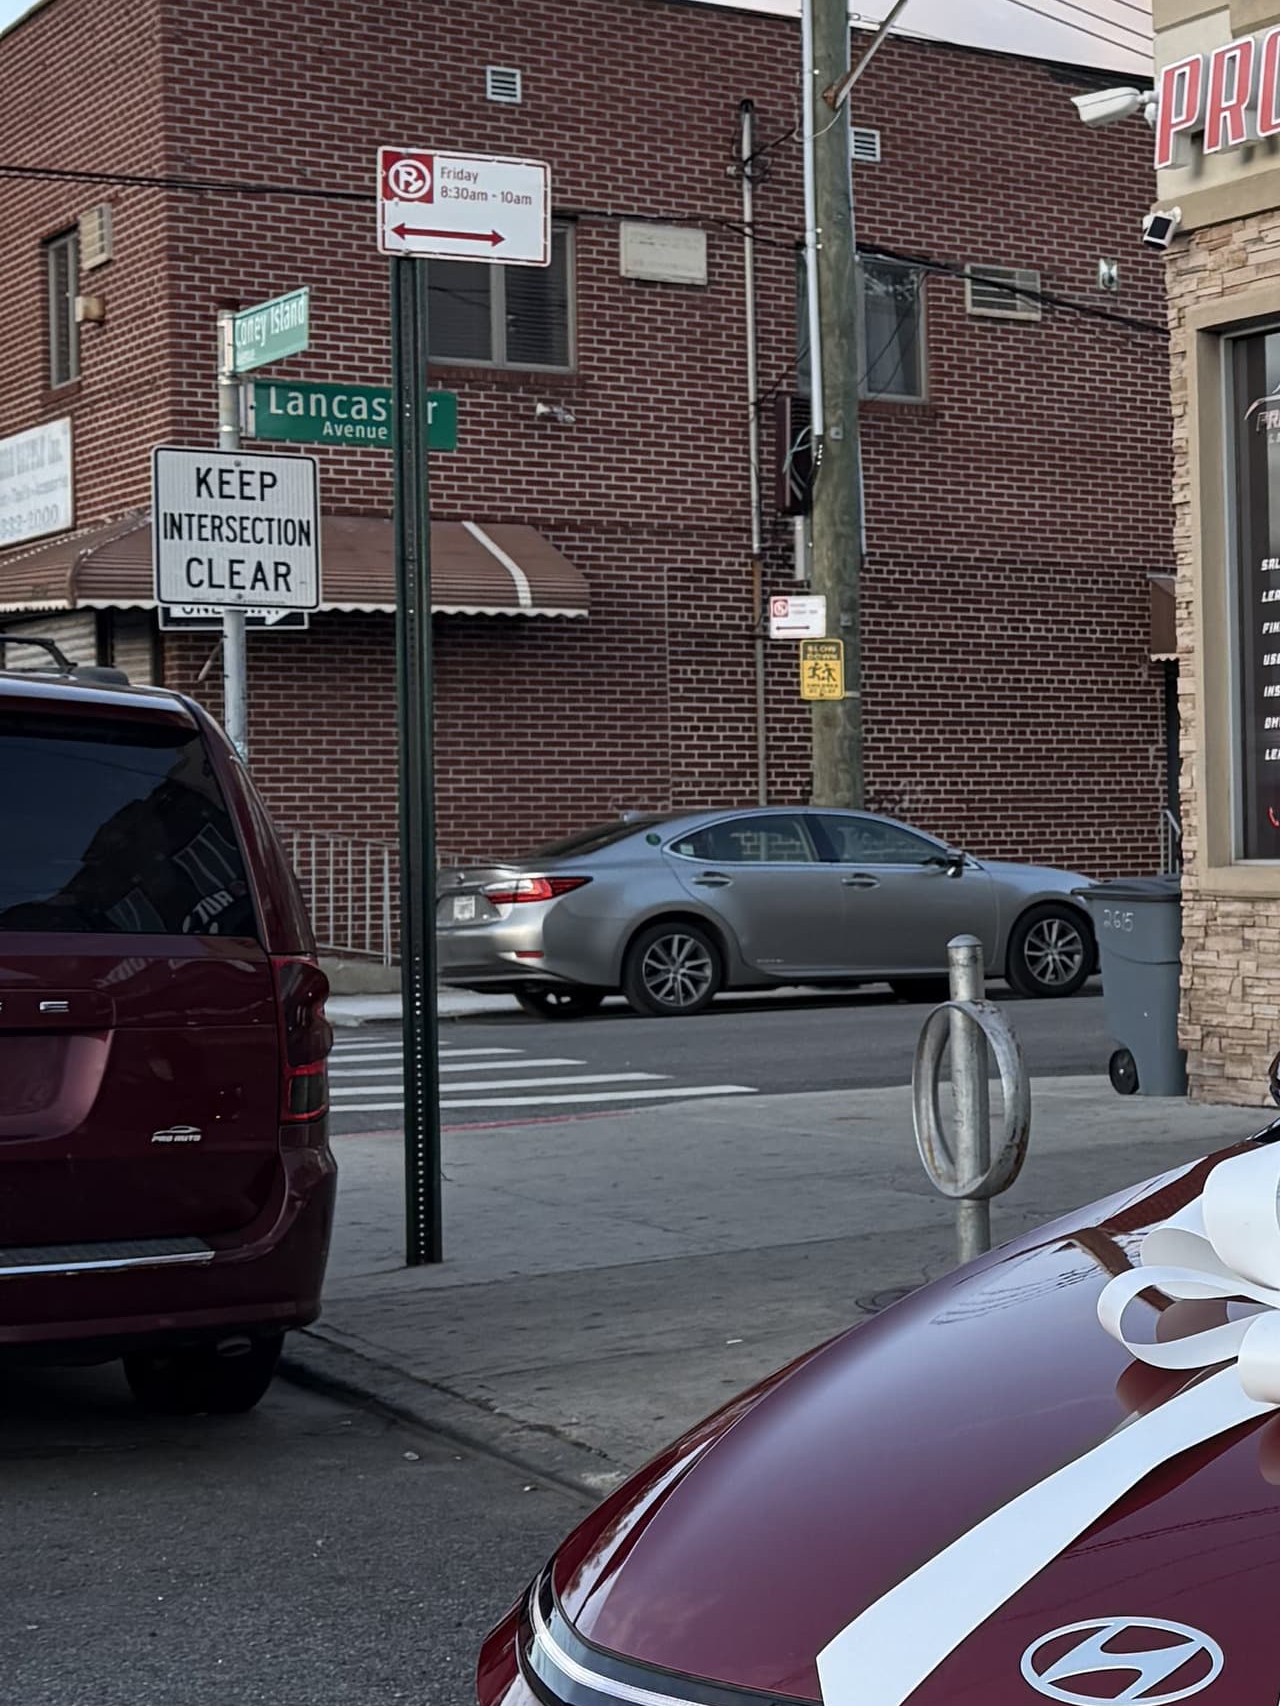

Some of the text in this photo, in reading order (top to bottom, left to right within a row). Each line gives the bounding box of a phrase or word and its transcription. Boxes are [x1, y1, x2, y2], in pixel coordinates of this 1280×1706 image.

[440, 166, 479, 184] Friday
[440, 185, 488, 202] 8:30am
[501, 191, 532, 205] 10am
[270, 294, 305, 334] Island
[268, 385, 438, 426] Lancasr
[322, 421, 388, 441] Avenue
[195, 466, 277, 502] KEEP
[163, 511, 311, 547] INTERSECTION
[186, 557, 292, 593] CLEAR
